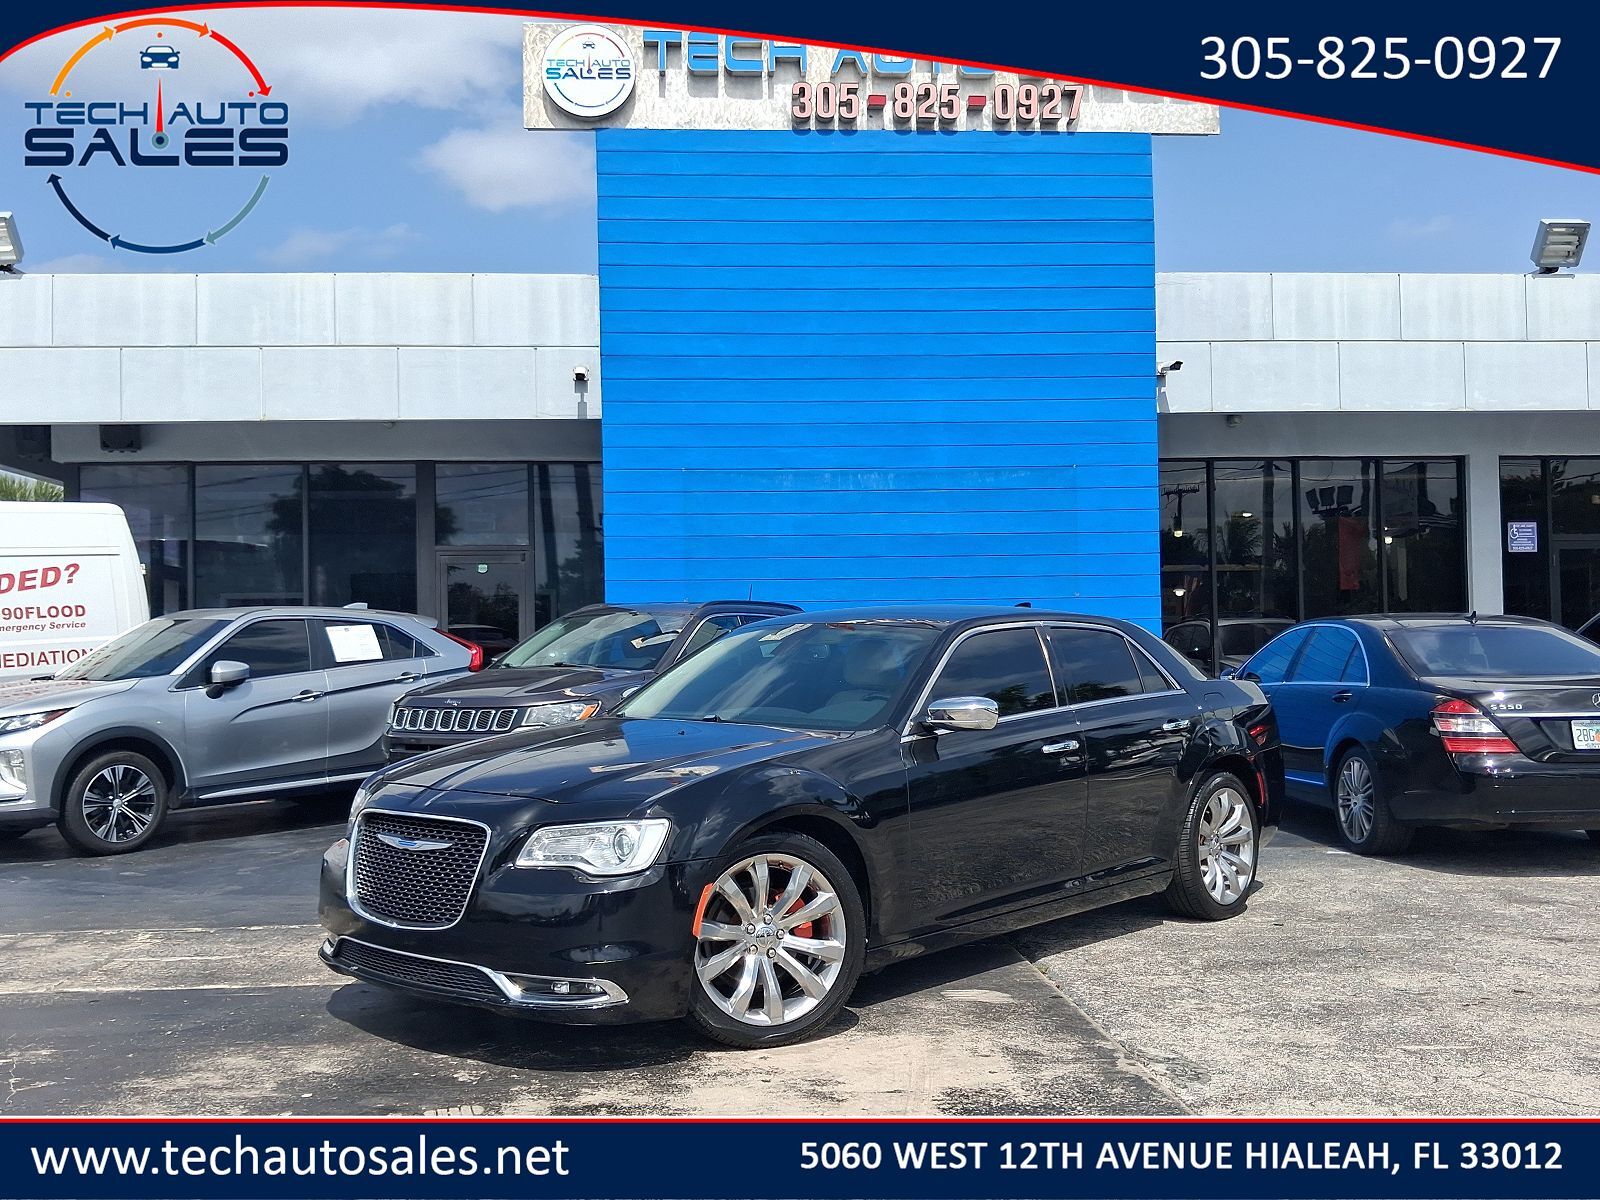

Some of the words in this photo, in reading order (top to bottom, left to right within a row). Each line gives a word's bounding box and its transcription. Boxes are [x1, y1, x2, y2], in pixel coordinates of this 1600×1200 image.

[642, 30, 807, 73] TECH
[546, 59, 586, 67] TECH
[591, 59, 631, 67] AUTO
[545, 67, 632, 80] SALES
[791, 81, 1084, 120] 305-825-0927
[0, 563, 80, 594] DED?
[1, 605, 86, 620] 90FLOOD
[49, 621, 86, 631] Service
